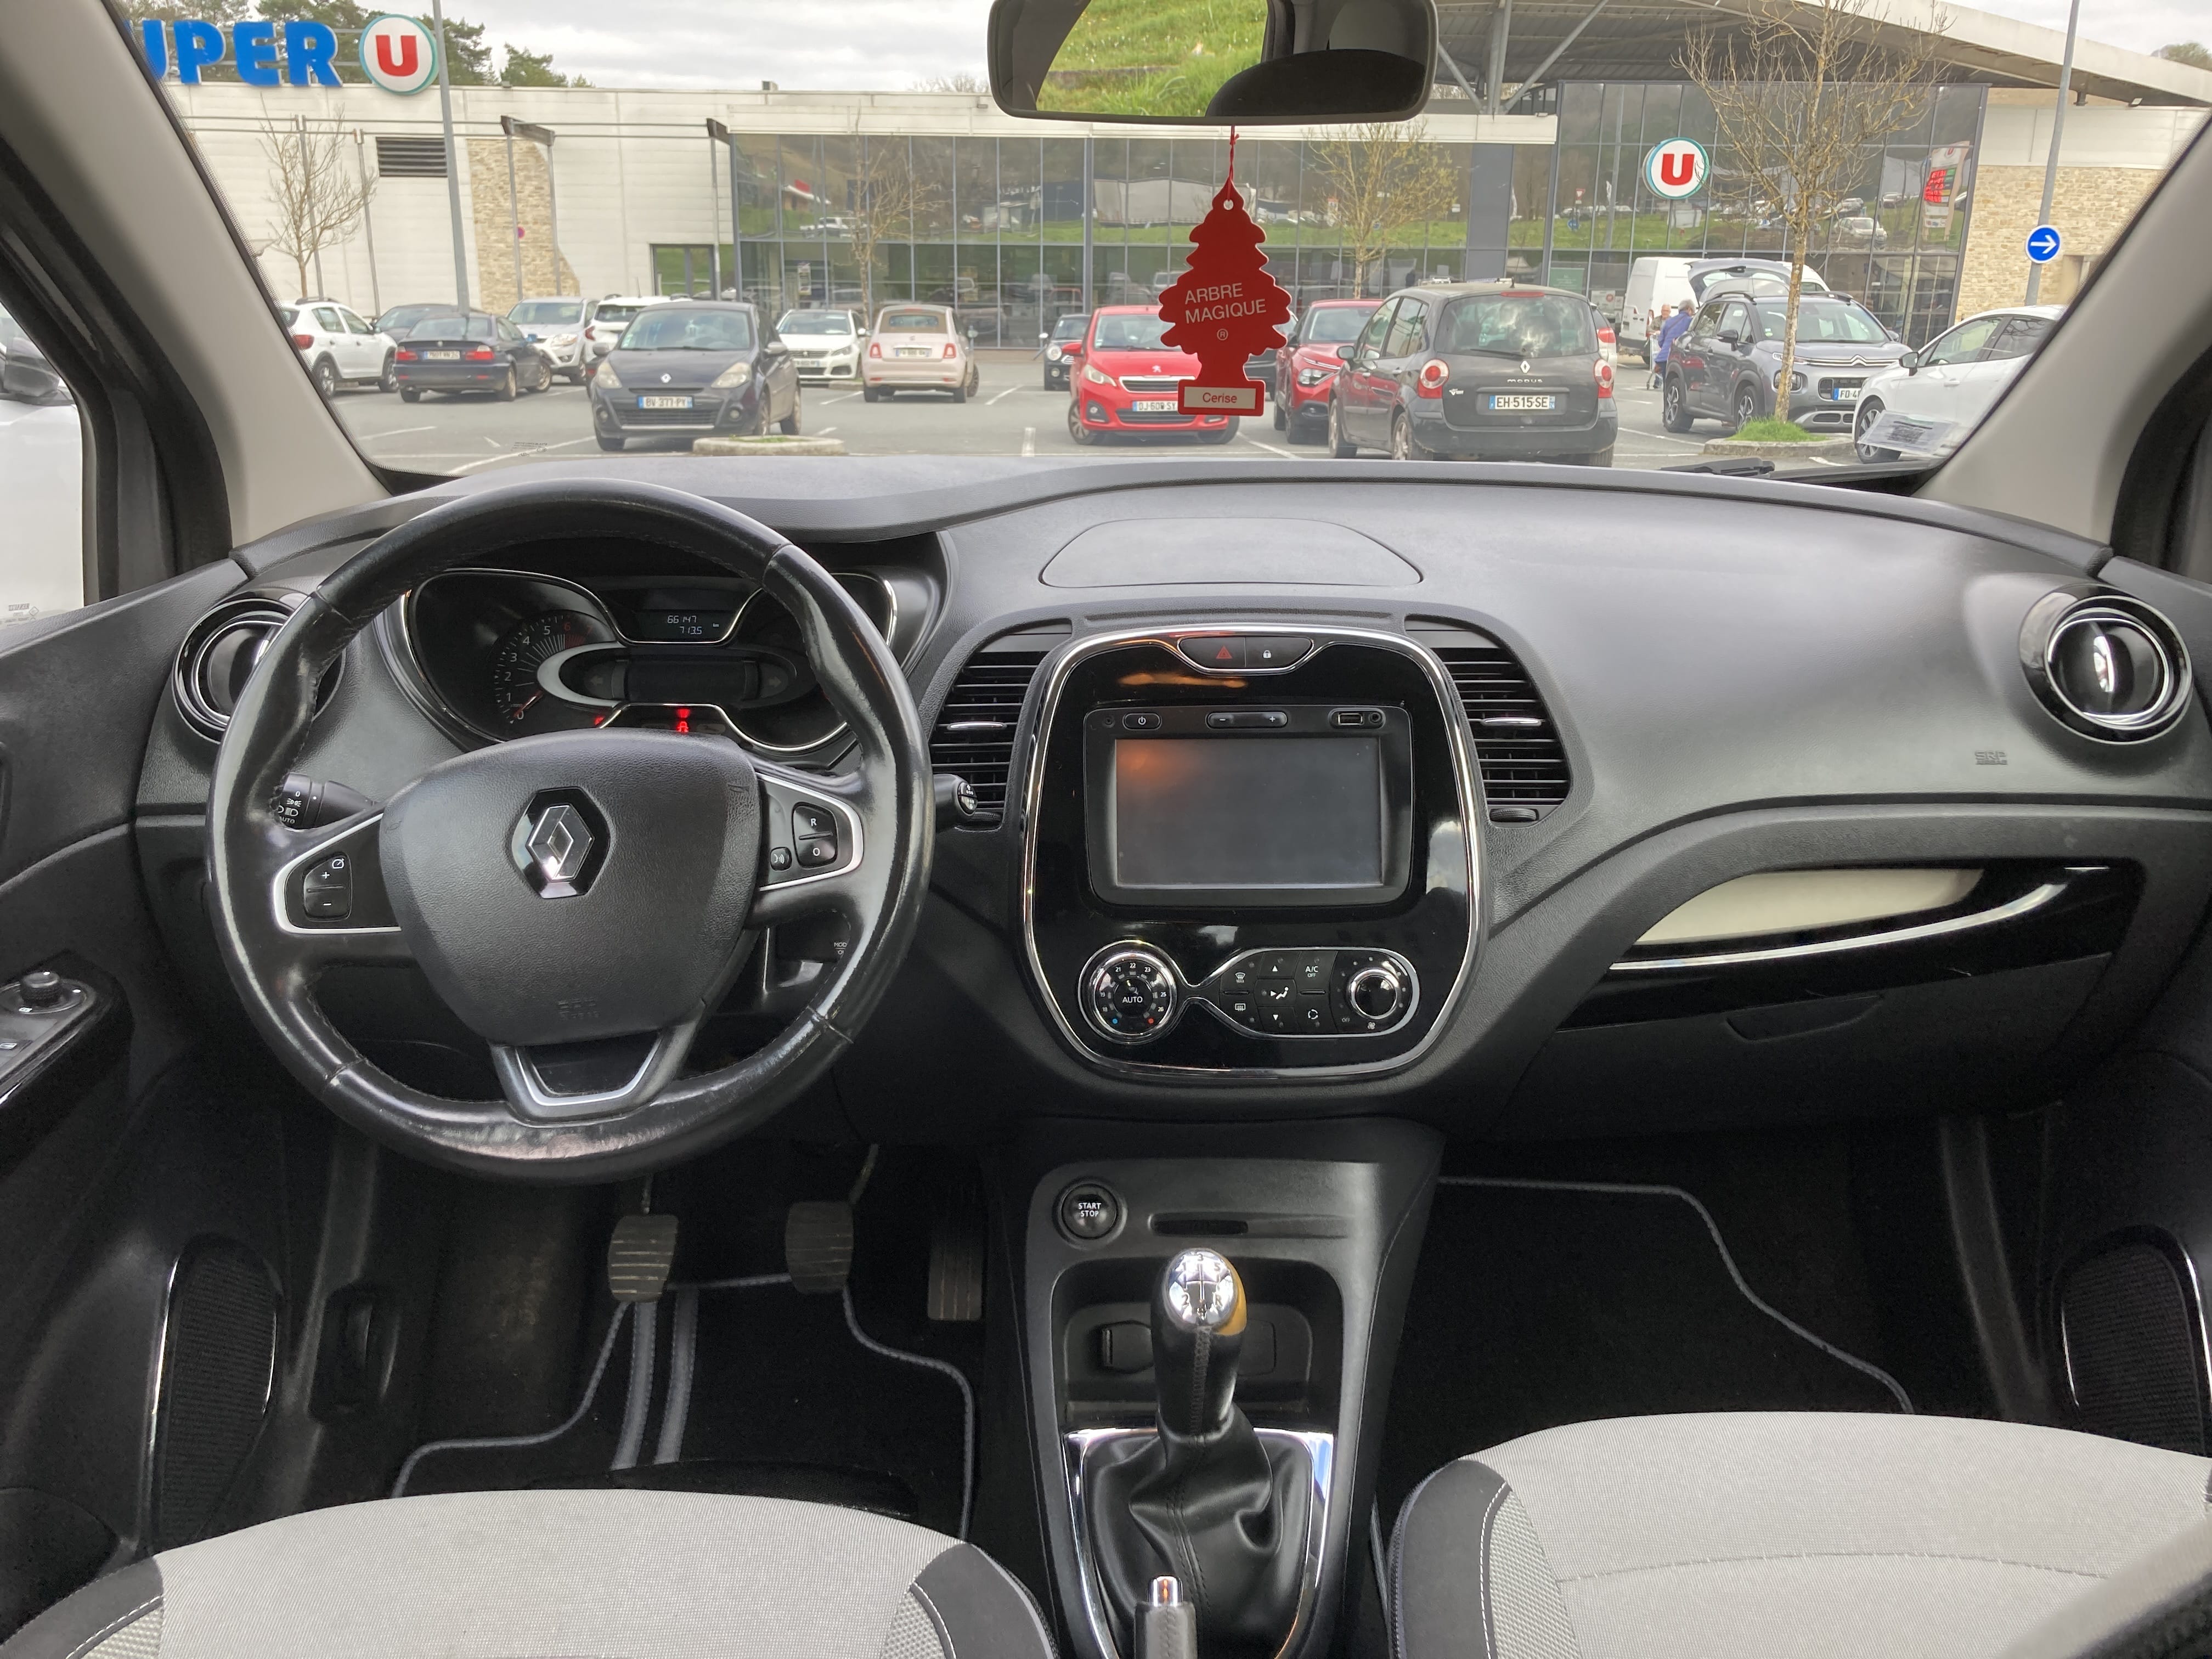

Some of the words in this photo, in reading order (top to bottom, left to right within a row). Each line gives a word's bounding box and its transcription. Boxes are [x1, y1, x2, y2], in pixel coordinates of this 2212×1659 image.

[376, 35, 419, 76] U
[1661, 154, 1695, 185] U
[1184, 283, 1243, 304] ARBRE
[1185, 298, 1267, 324] MAGIQUE
[1202, 392, 1238, 404] Cerise
[544, 625, 551, 635] 5
[522, 636, 531, 645] 4
[510, 652, 517, 662] 3
[504, 672, 512, 681] 2
[506, 692, 511, 702] 1
[810, 817, 817, 827] R
[1197, 1253, 1204, 1261] 3
[1182, 1294, 1189, 1305] 2
[1215, 1294, 1223, 1307] R
